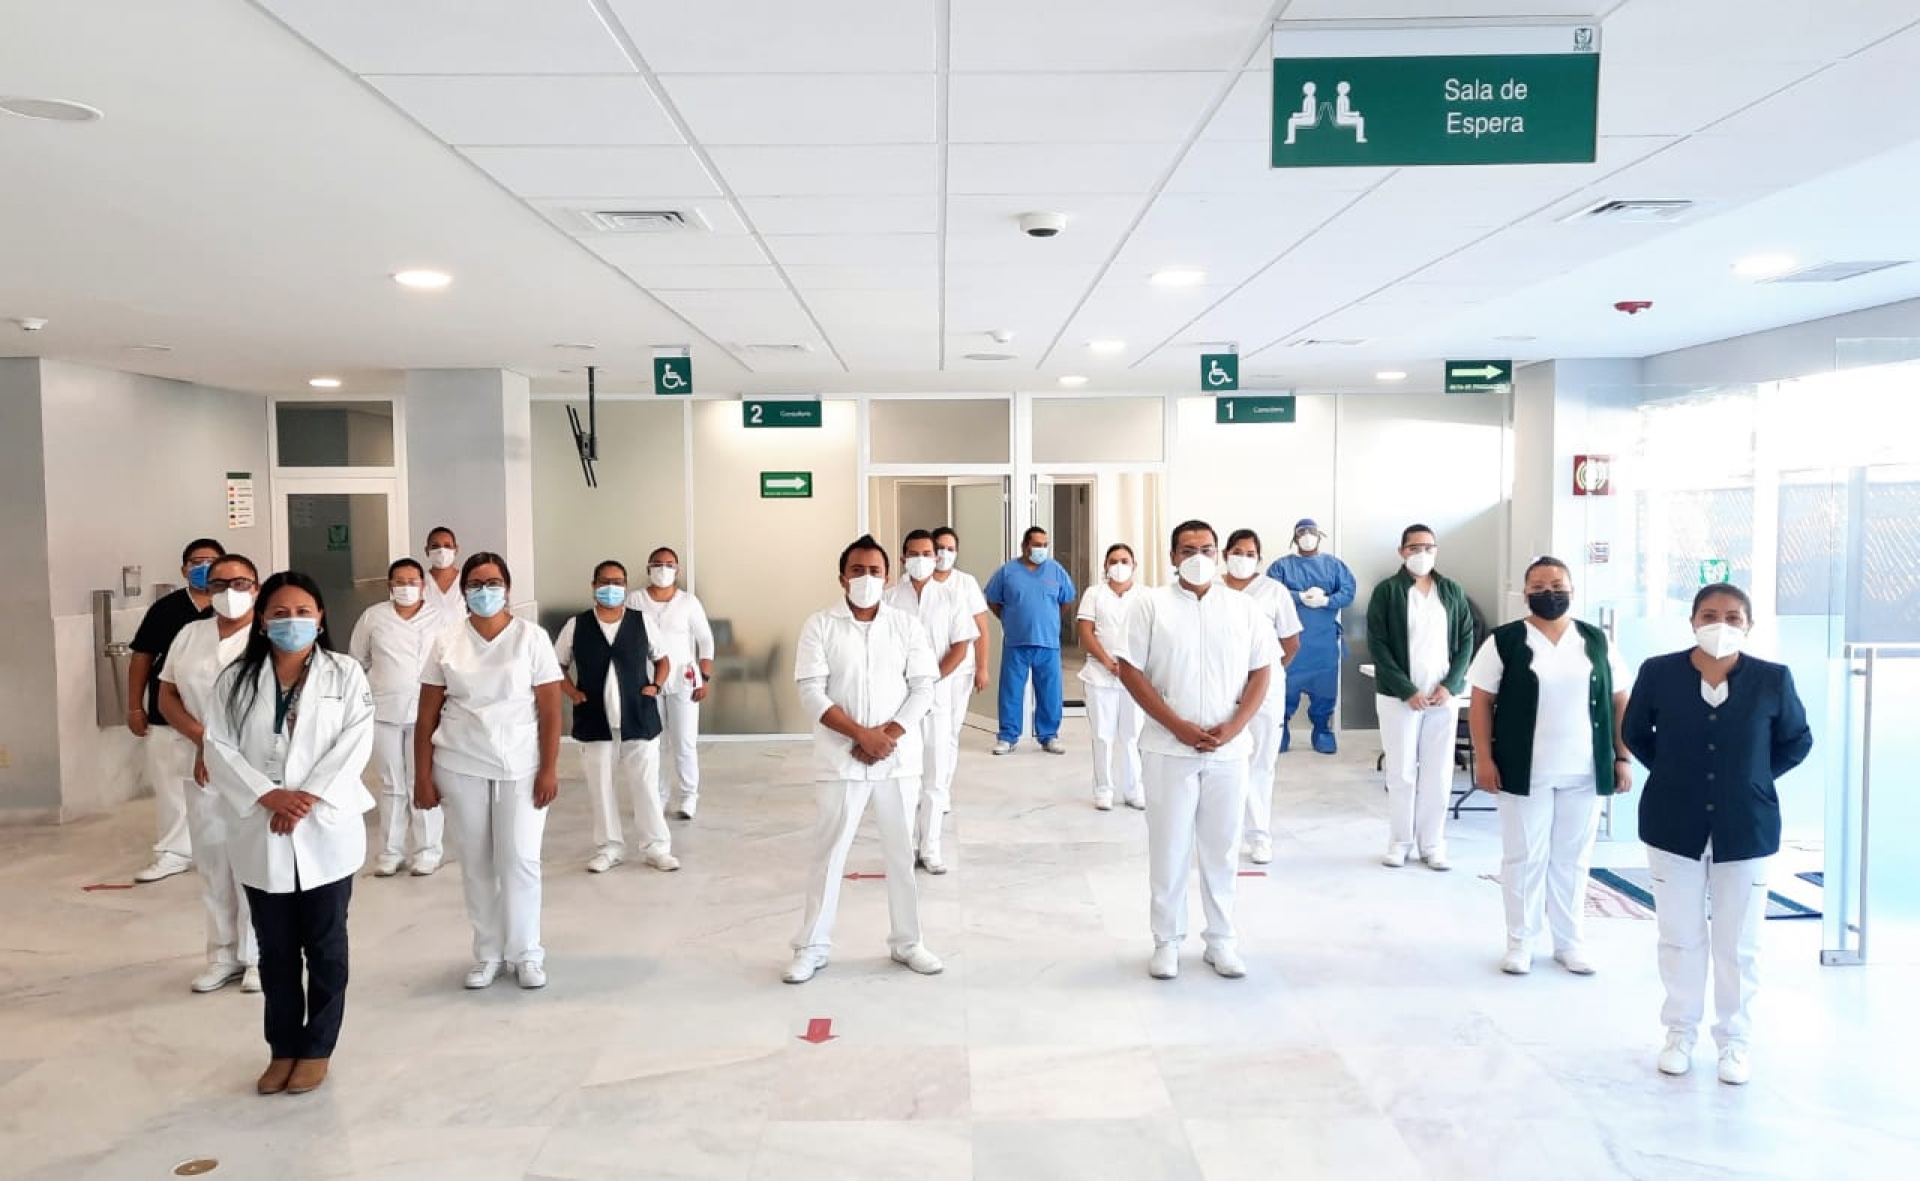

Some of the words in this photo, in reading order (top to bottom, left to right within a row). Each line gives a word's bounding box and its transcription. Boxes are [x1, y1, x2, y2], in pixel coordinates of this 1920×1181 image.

[1445, 78, 1494, 100] Sala
[1500, 78, 1528, 100] de
[1447, 112, 1524, 138] Espera
[750, 404, 763, 423] 2
[1224, 400, 1234, 420] 1
